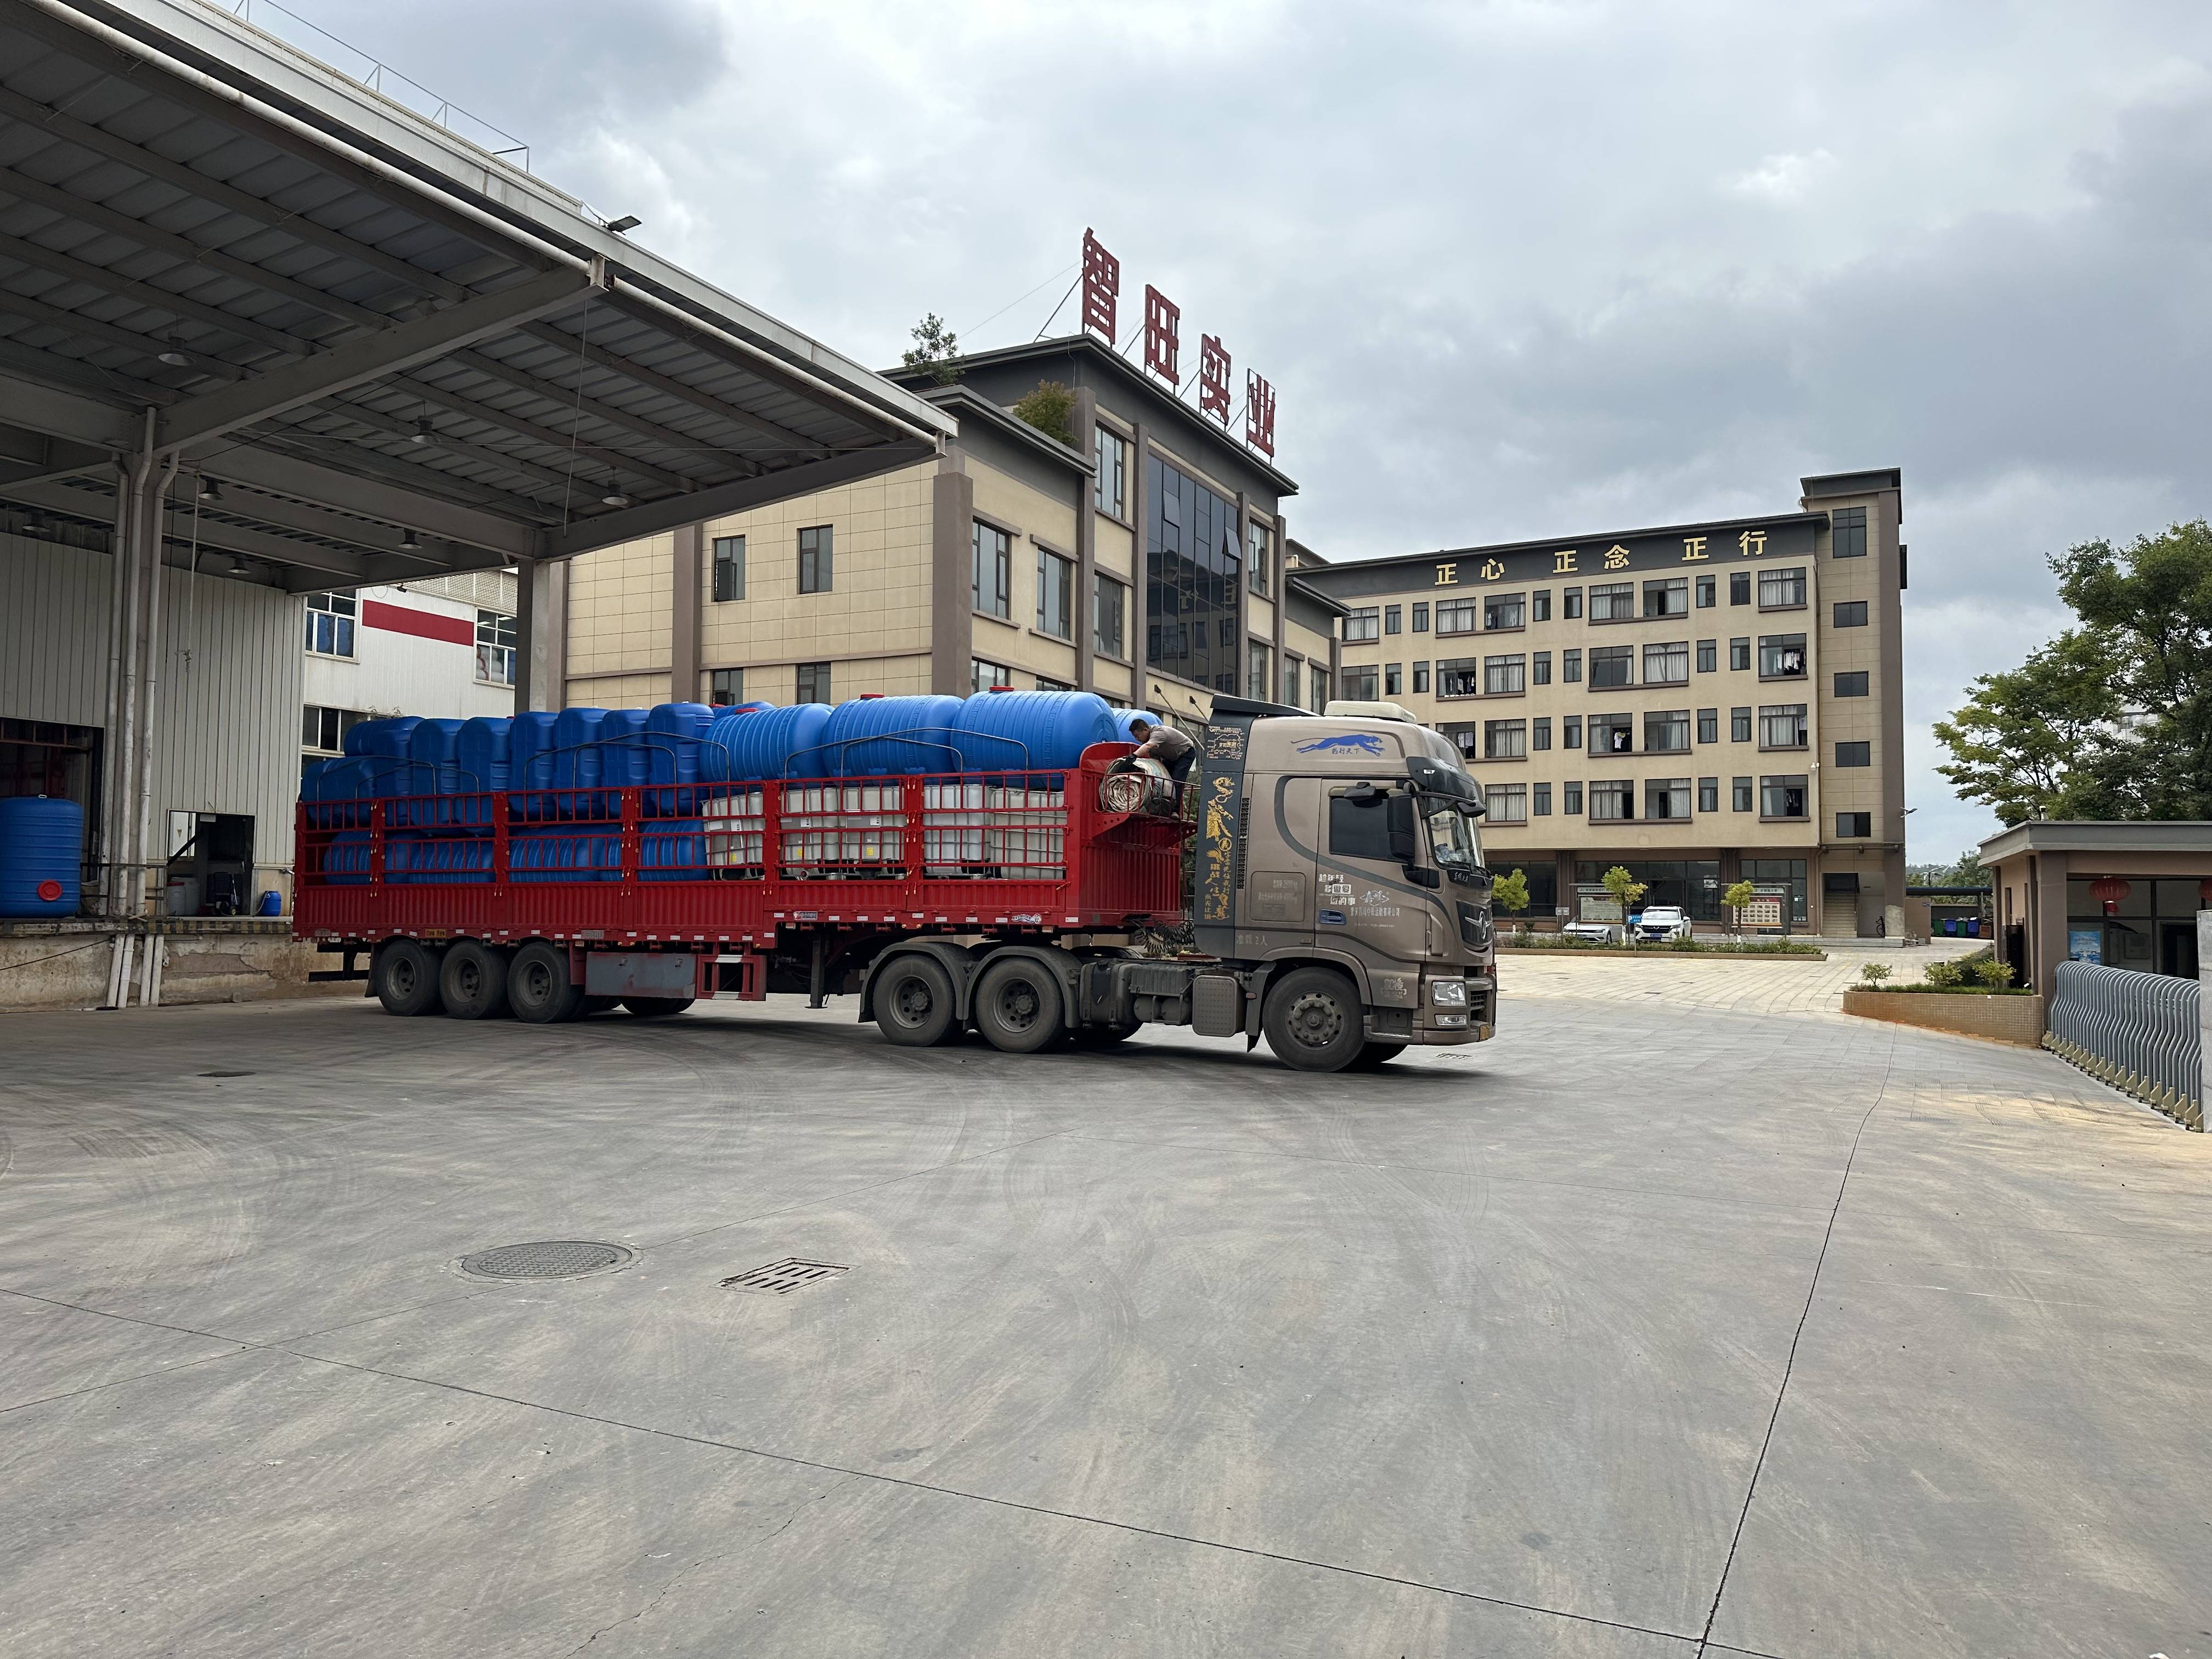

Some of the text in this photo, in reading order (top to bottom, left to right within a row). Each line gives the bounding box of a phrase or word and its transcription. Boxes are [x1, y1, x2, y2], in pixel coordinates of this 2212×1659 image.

[1082, 227, 1276, 457] 智旺实业
[1435, 531, 1767, 585] 正心 正念 正行
